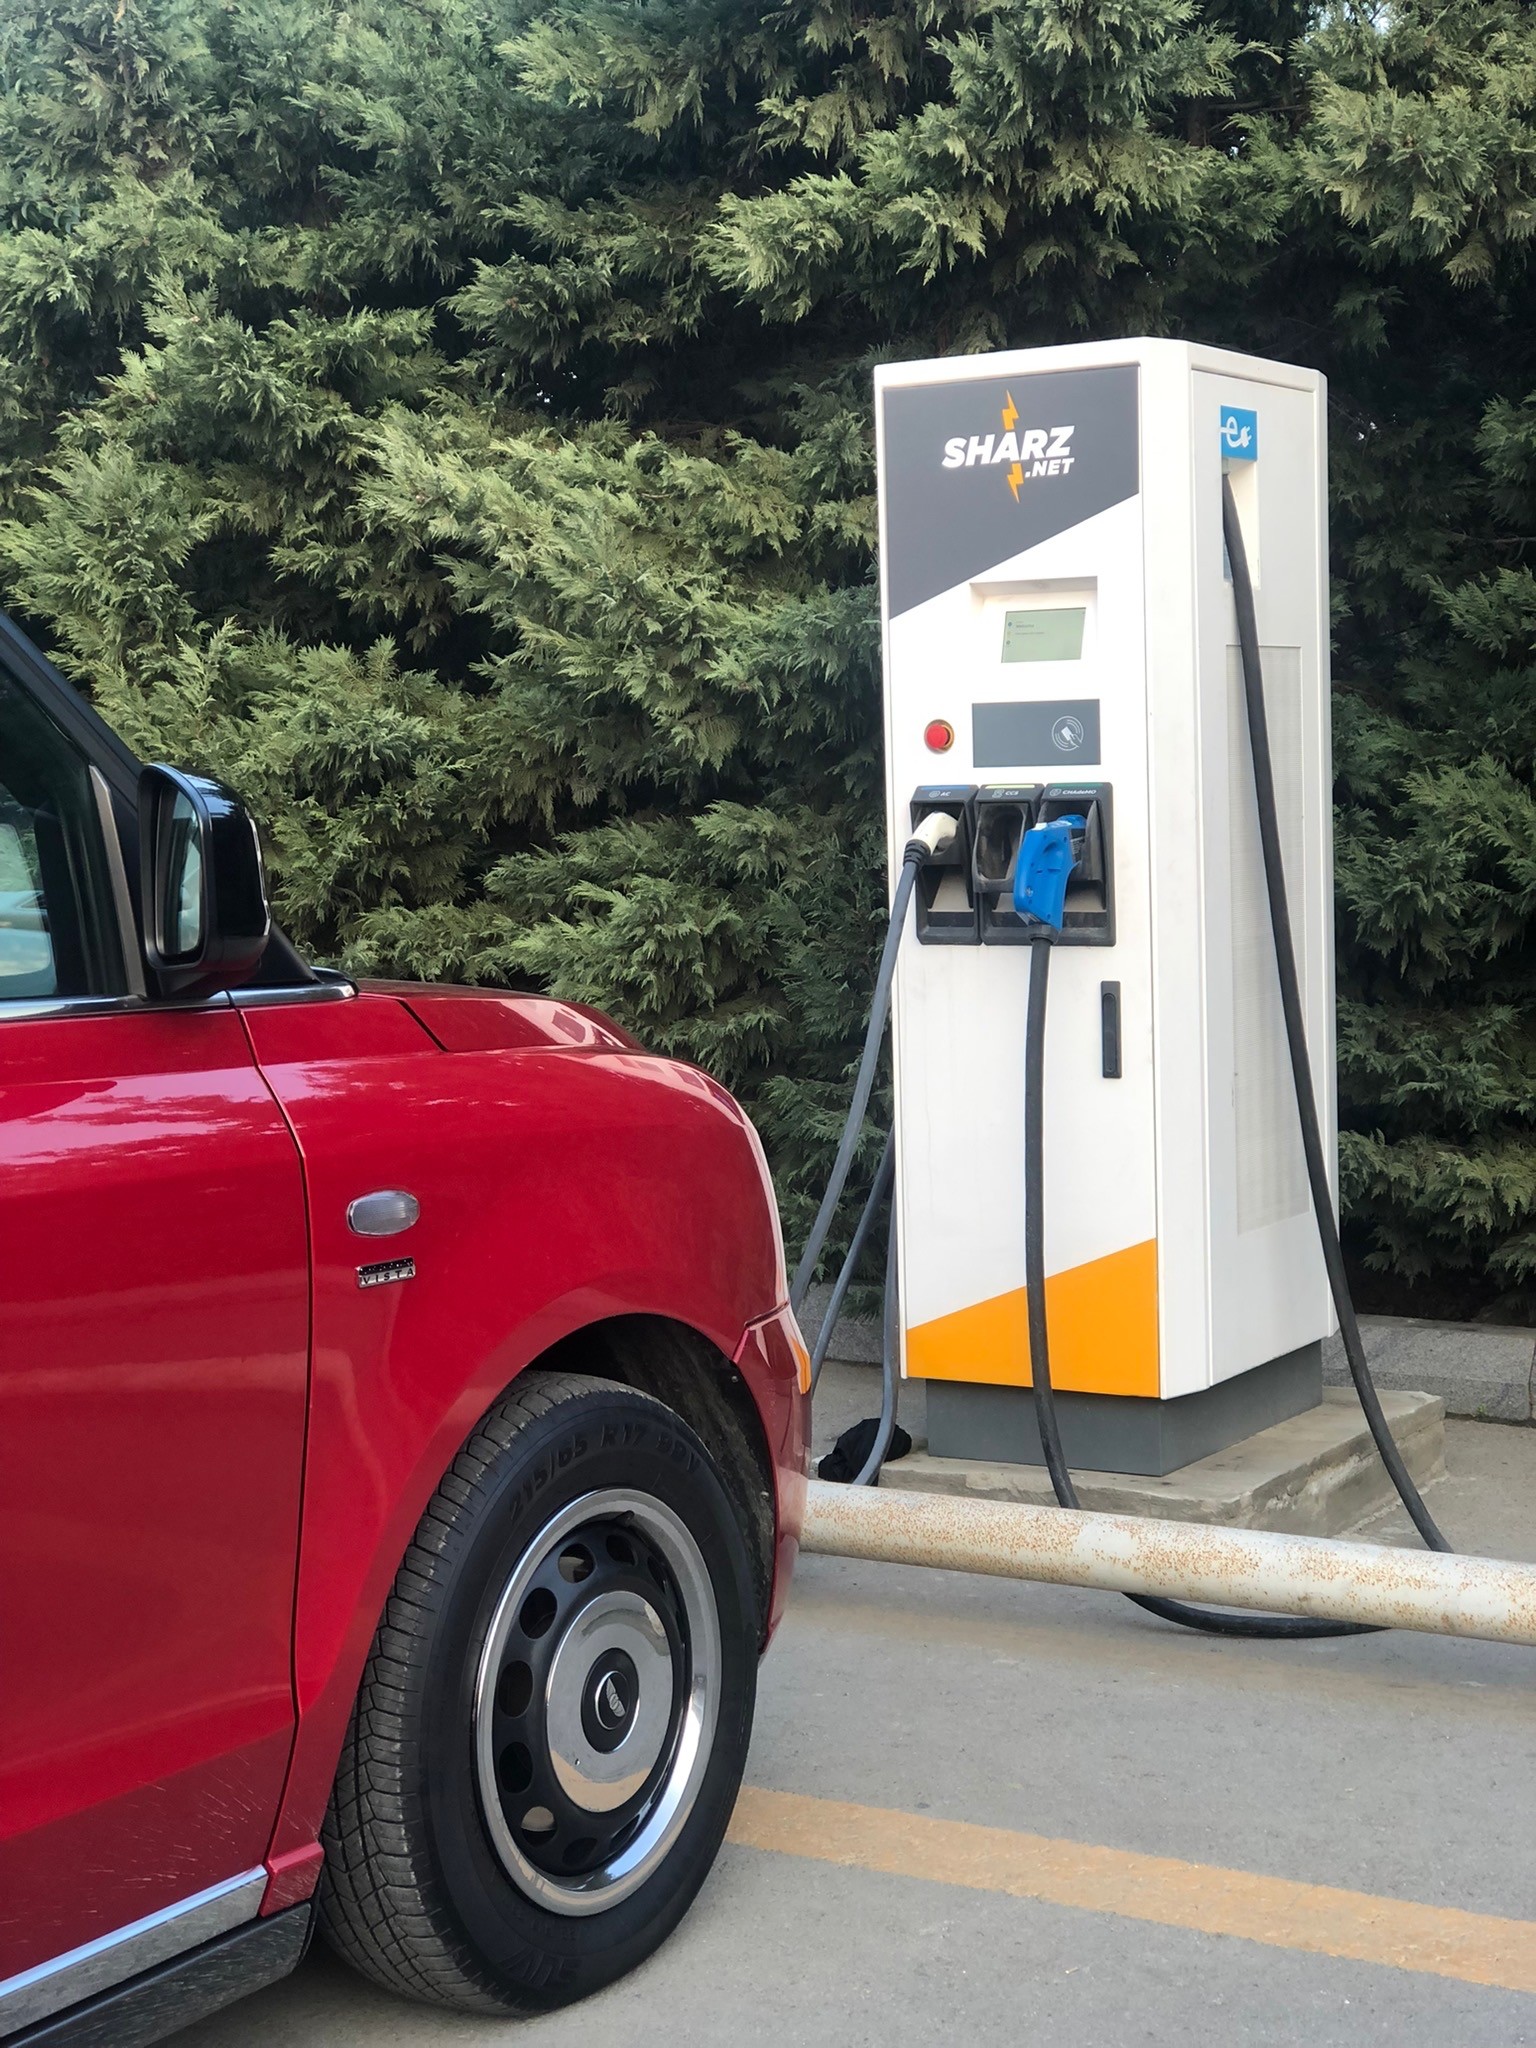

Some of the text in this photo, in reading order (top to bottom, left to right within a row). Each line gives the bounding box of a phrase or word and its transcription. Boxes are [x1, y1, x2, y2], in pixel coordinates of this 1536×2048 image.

[942, 425, 1075, 468] SHARZ
[1025, 458, 1075, 478] .NET
[363, 1268, 413, 1284] VISTA
